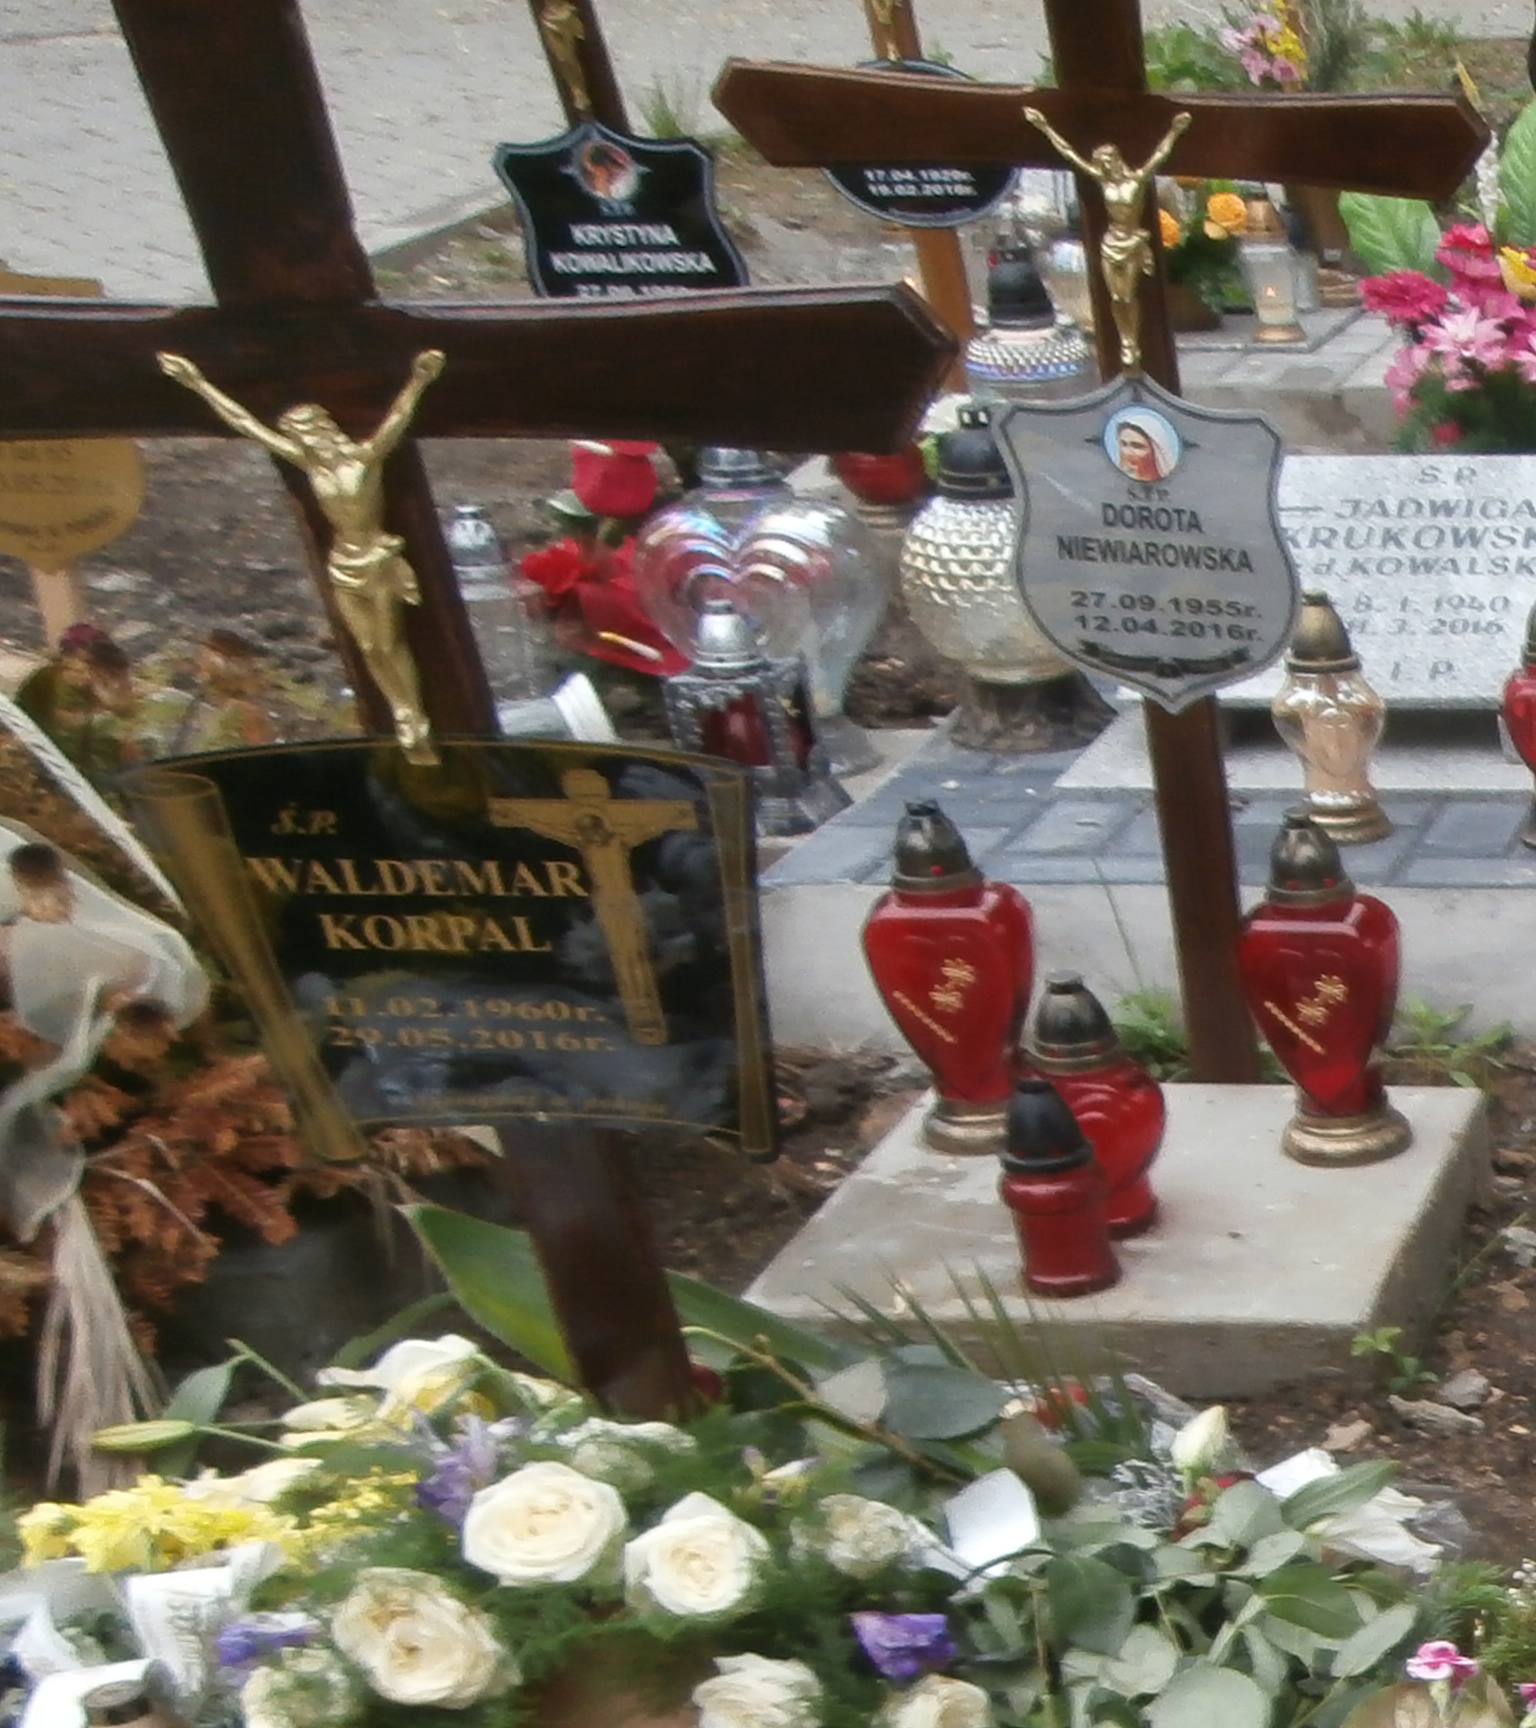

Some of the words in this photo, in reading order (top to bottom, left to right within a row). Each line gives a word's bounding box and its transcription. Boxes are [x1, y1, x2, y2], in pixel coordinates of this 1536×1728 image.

[568, 223, 682, 247] KRYSTYNA
[1101, 502, 1204, 534] DOROTA
[1056, 535, 1254, 573] NIEWIAROWSKA
[1070, 590, 1262, 618] 27.09.1955r.
[1074, 614, 1263, 642] 12.04.2016r.
[246, 856, 590, 899] WALDEMAR
[318, 912, 553, 954] KORPAL
